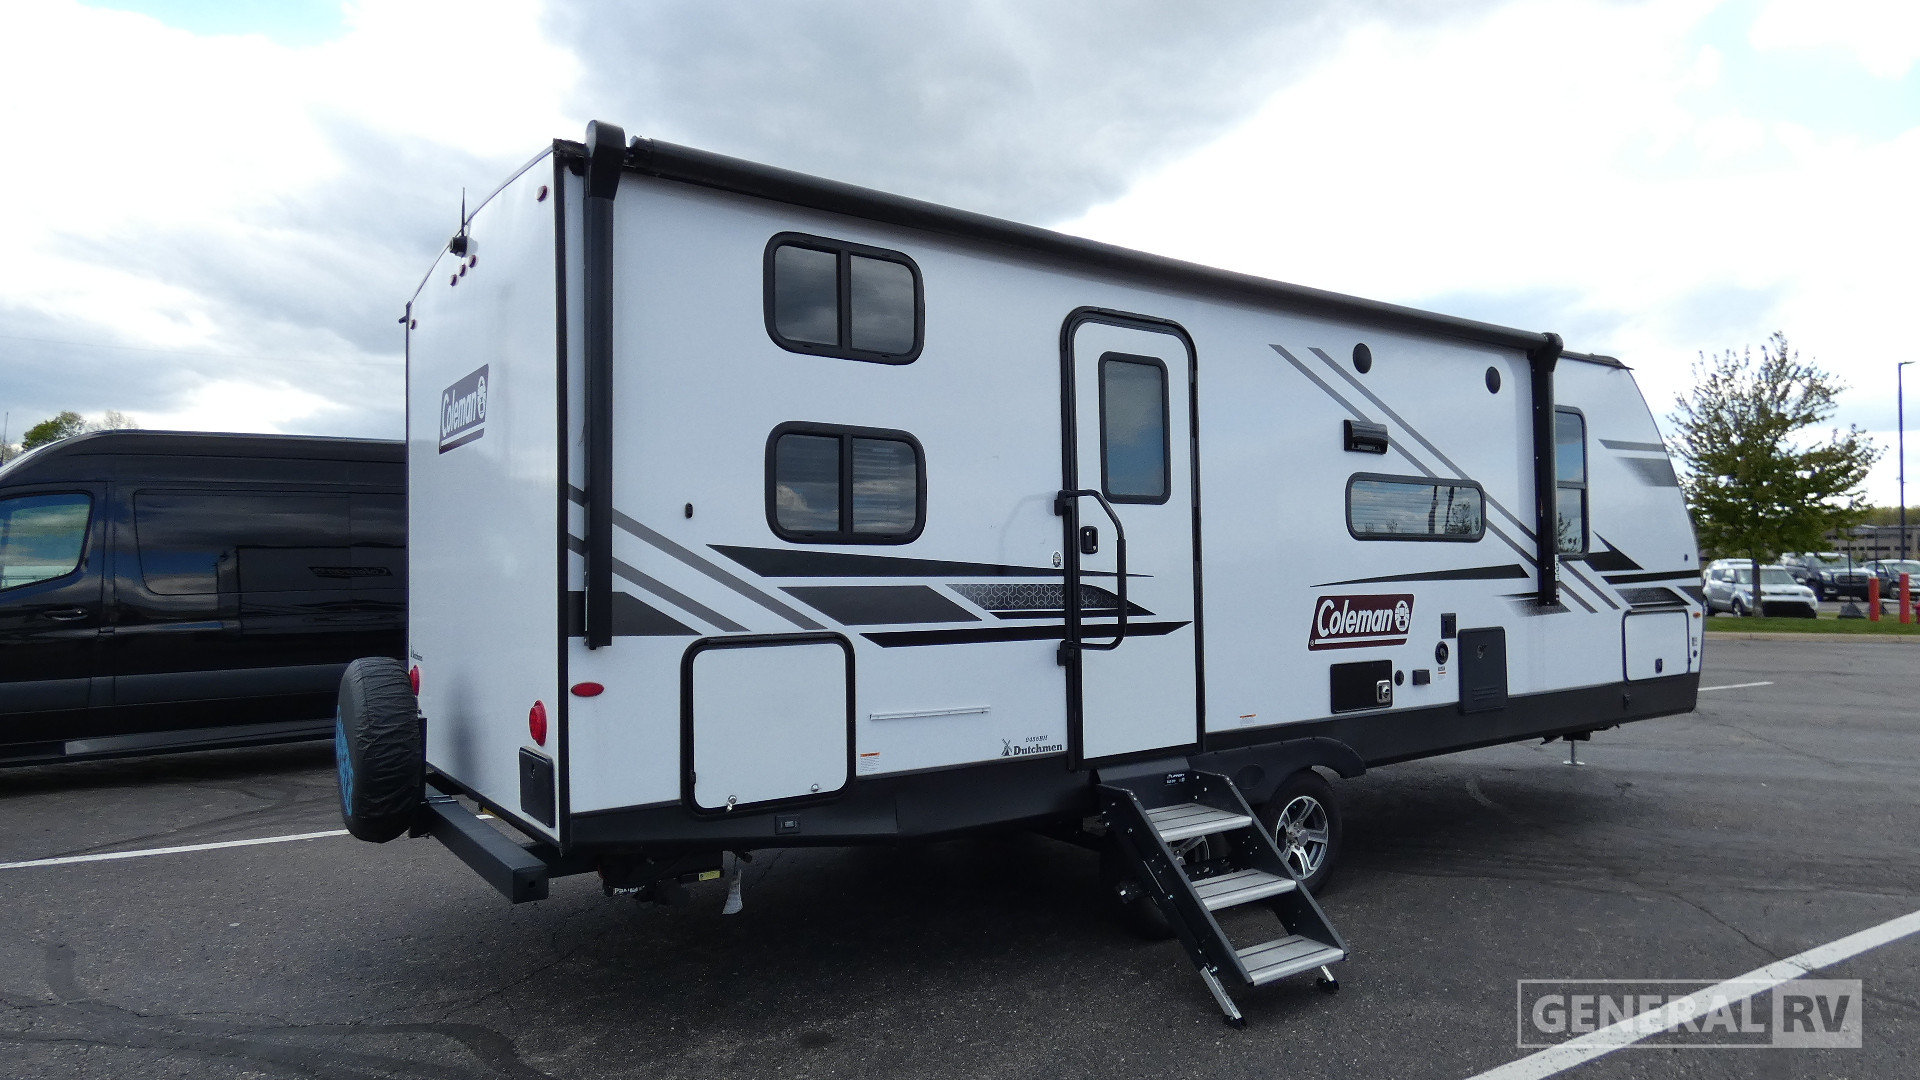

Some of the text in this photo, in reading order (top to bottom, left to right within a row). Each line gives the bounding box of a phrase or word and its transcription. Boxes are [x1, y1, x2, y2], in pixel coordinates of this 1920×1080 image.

[442, 389, 477, 438] Coleman
[1317, 599, 1394, 638] Coleman
[1013, 744, 1063, 755] Dutchmen
